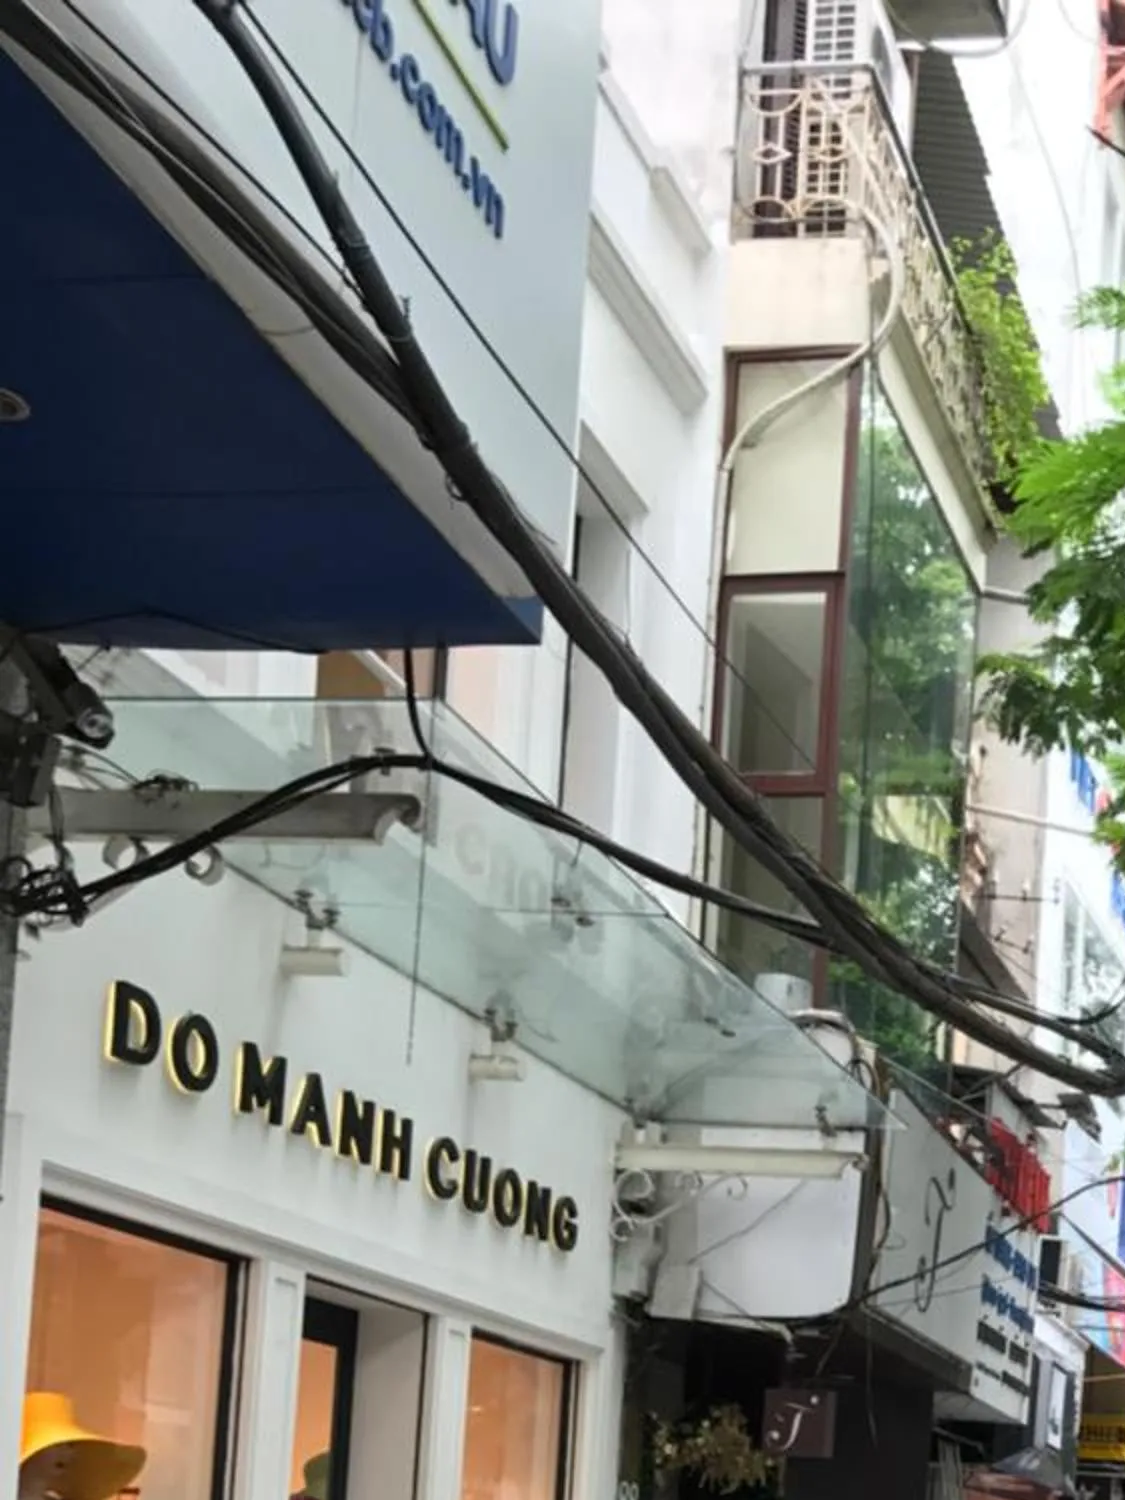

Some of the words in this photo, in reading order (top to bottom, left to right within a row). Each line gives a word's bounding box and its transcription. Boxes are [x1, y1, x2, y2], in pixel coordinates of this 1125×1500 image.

[341, 0, 504, 239] eb.com.vn
[104, 978, 220, 1095] DO
[232, 1040, 414, 1182] MANH
[424, 1135, 579, 1253] CUONG
